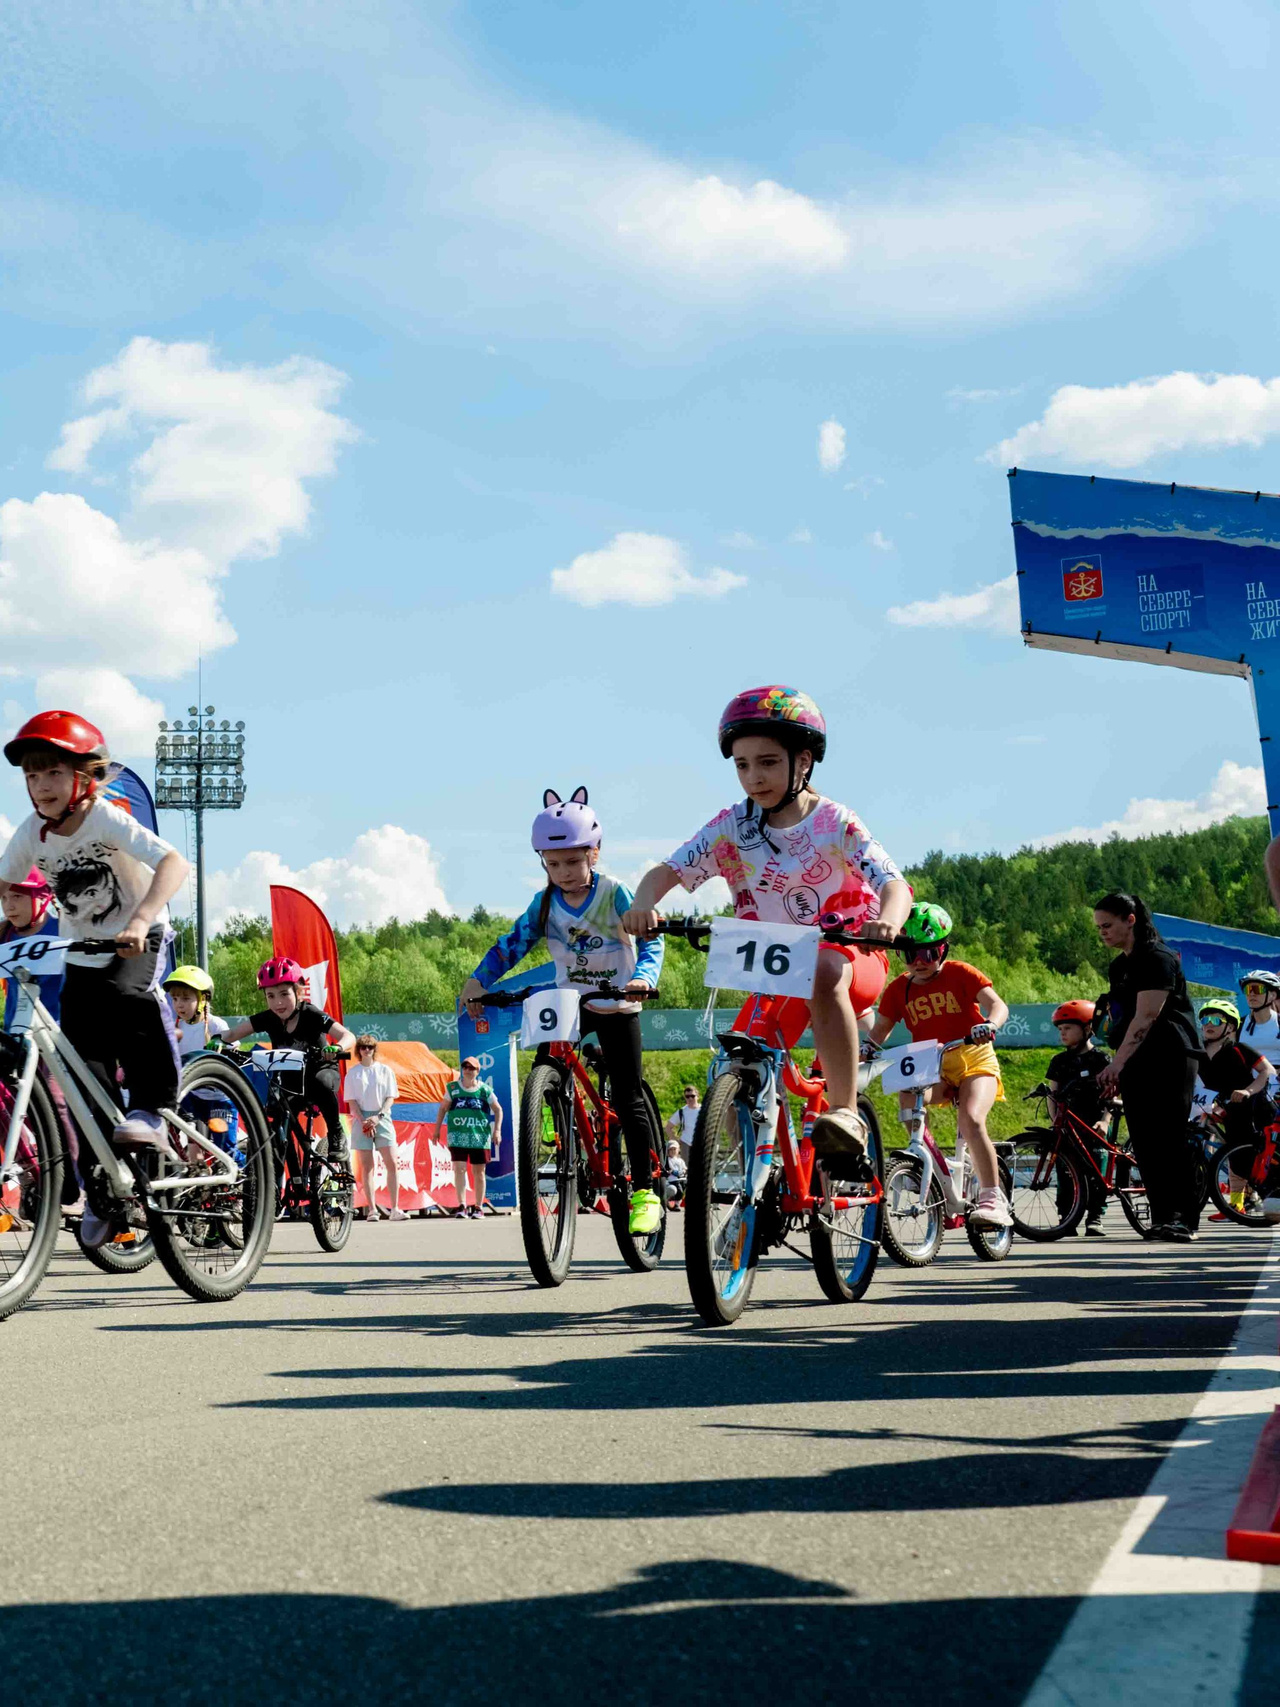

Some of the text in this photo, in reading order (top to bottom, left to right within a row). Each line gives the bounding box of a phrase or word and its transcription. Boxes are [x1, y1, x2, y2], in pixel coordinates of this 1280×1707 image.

[1137, 574, 1158, 592] НА
[1245, 582, 1267, 600] НА
[1139, 590, 1192, 613] СЕВЕРЕ
[1141, 610, 1191, 632] СПОРТ!
[10, 940, 51, 962] 10
[735, 940, 791, 976] 16
[539, 1008, 558, 1031] 9
[905, 990, 962, 1027] USPA
[265, 1051, 293, 1064] 17
[900, 1056, 915, 1077] 6
[453, 1116, 489, 1127] СУДЬЯ
